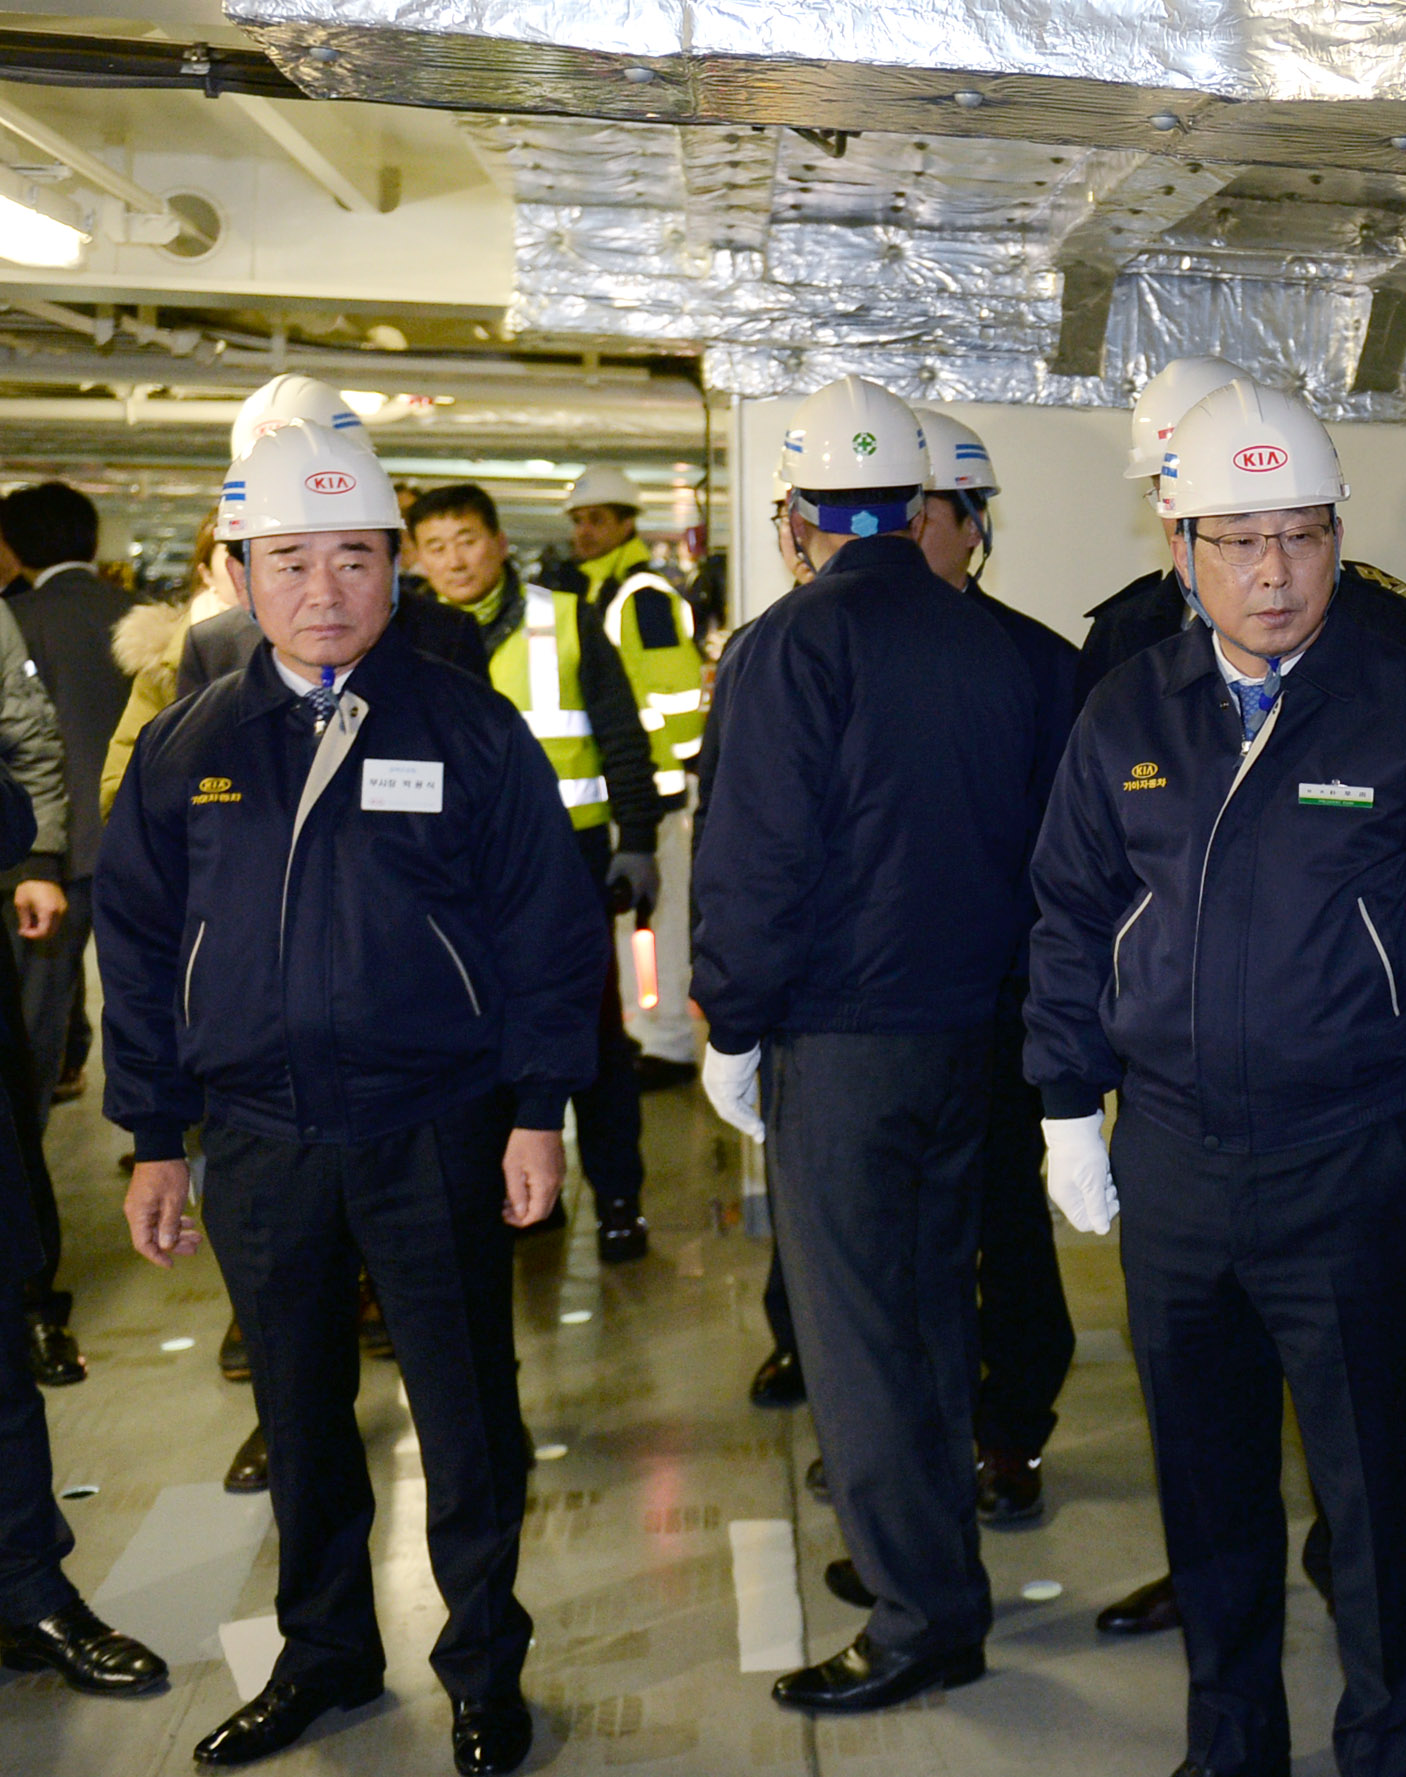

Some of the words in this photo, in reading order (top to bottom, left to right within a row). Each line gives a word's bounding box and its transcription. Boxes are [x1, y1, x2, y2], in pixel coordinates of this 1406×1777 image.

[1242, 451, 1280, 467] KIA
[314, 477, 349, 489] KIA
[1123, 777, 1167, 792] 기아자동차
